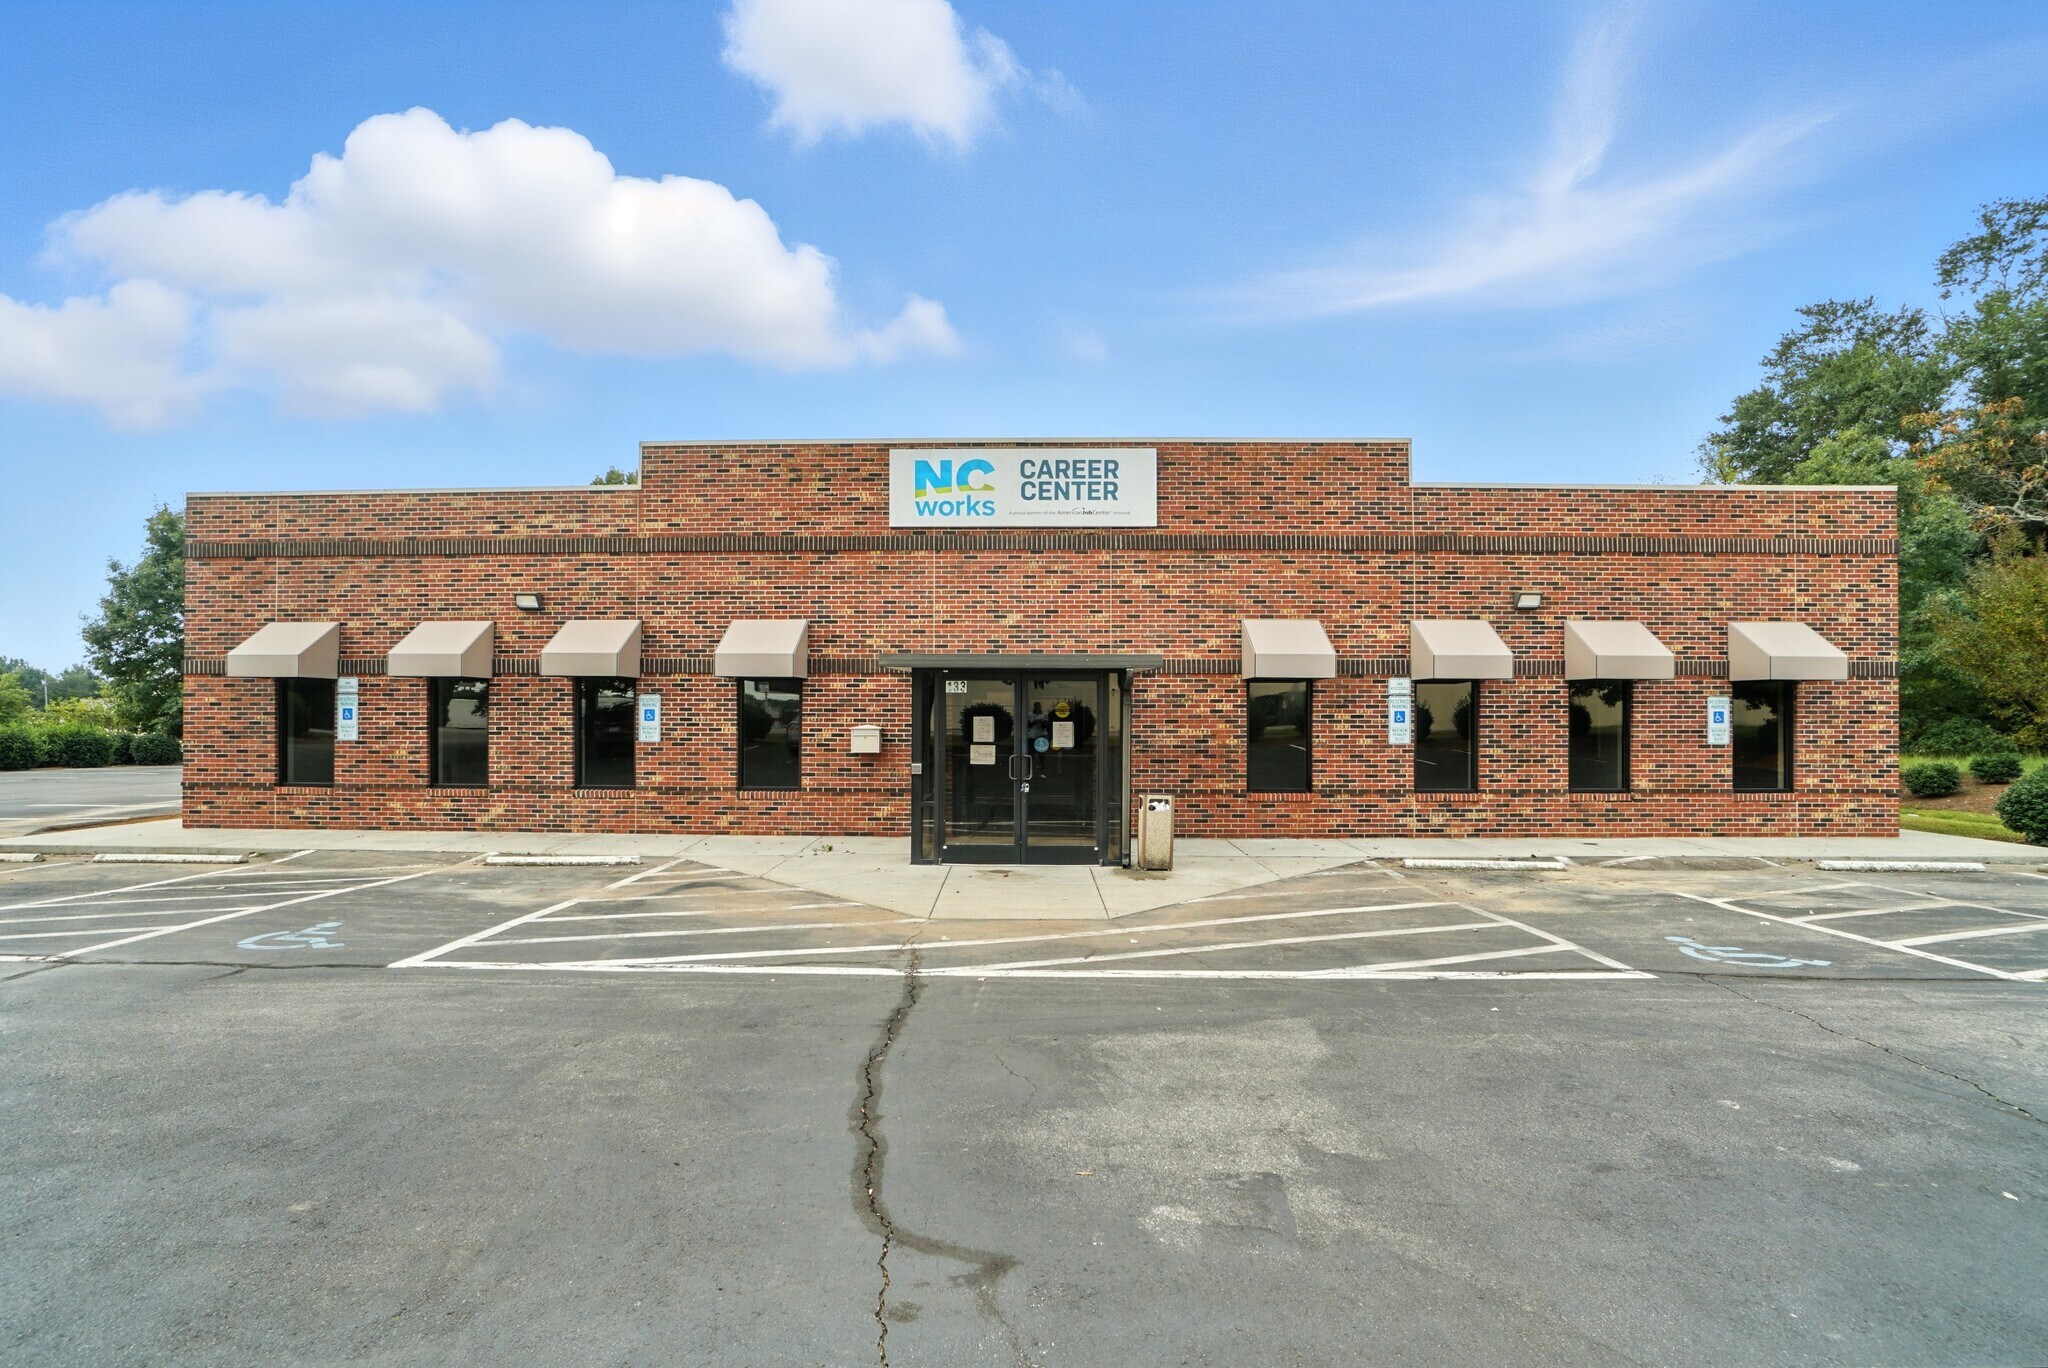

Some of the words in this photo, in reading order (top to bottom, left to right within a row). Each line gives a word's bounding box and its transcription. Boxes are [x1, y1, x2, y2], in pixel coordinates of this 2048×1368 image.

[914, 459, 996, 498] NC
[1020, 459, 1119, 480] CAREER
[1020, 480, 1119, 501] CENTER
[914, 494, 996, 517] works
